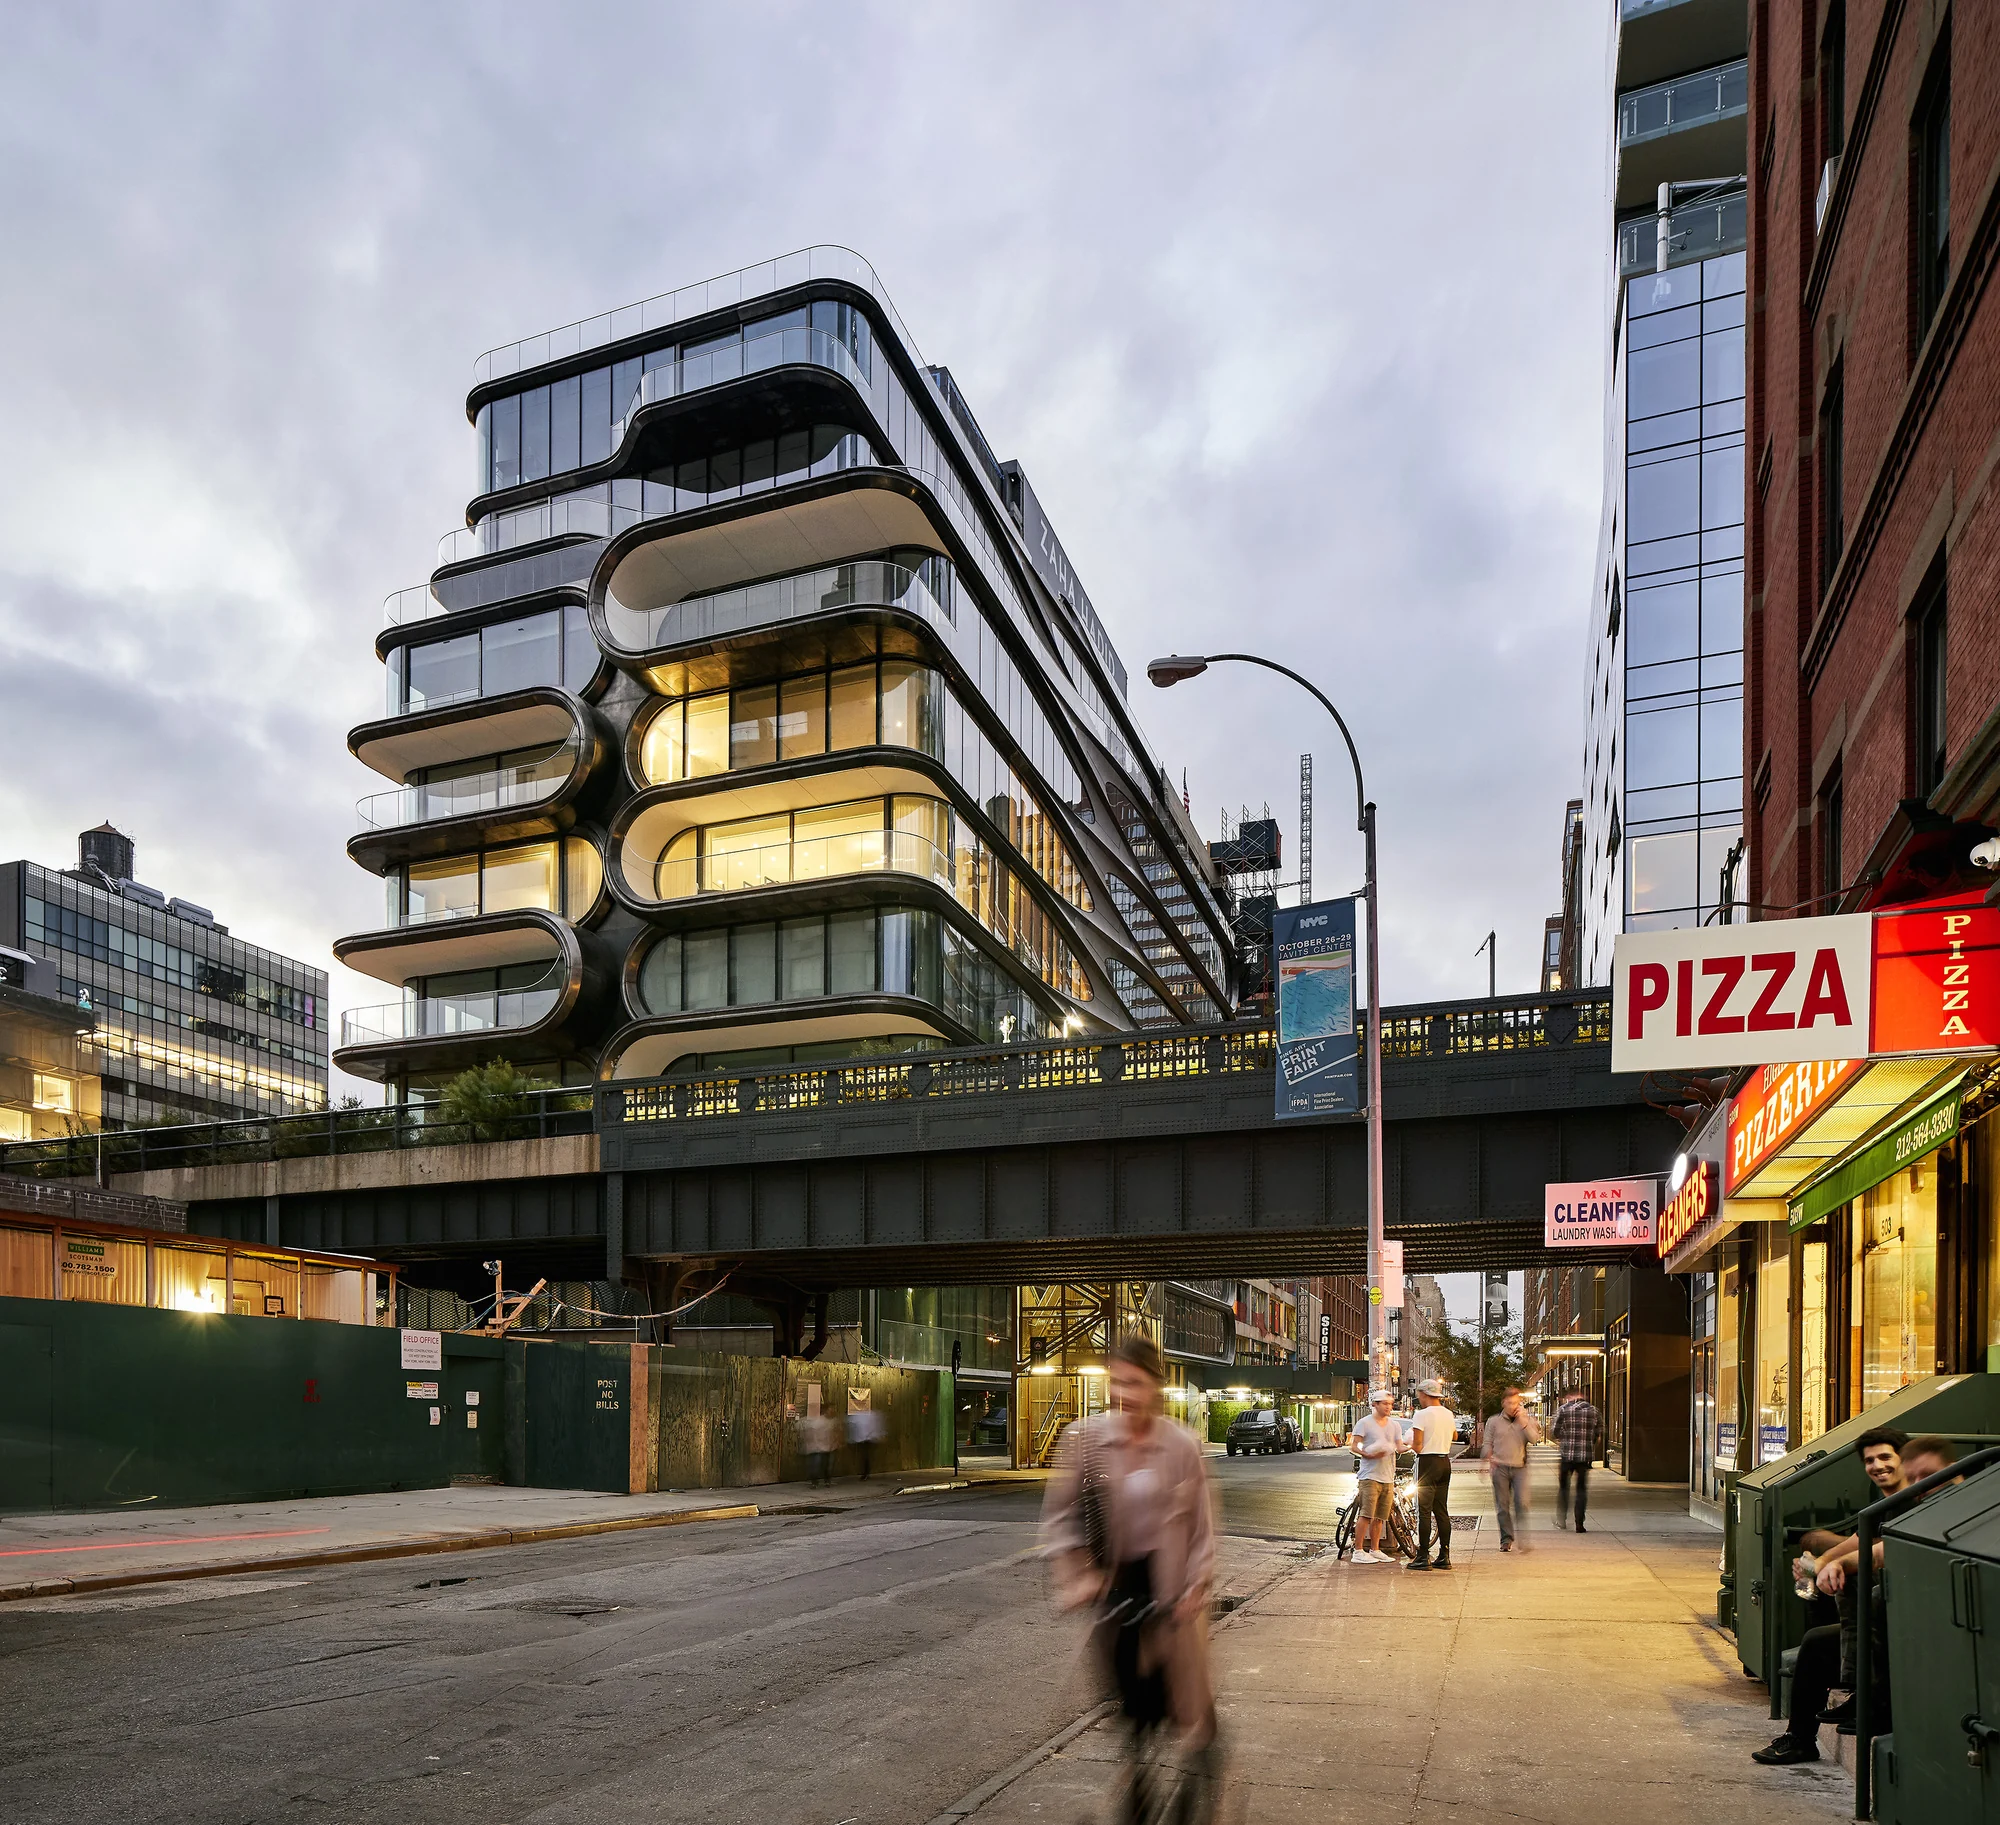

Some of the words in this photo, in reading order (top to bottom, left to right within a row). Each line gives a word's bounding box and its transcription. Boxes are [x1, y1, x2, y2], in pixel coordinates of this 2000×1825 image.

[1040, 519, 1076, 606] ZAHA
[1081, 597, 1115, 678] HADID
[1300, 915, 1328, 929] NYC
[1278, 938, 1322, 952] OCTOBER
[1278, 947, 1309, 960] JAVITS
[1313, 942, 1352, 954] CENTER
[1939, 915, 1972, 1036] PIZZA
[1628, 948, 1853, 1040] PIZZA
[1280, 1049, 1293, 1060] FINE
[1294, 1043, 1307, 1054] ART
[1281, 1040, 1326, 1069] PRINT
[1283, 1057, 1319, 1079] FAIR
[1291, 1098, 1308, 1107] IFPDA
[1895, 1102, 1955, 1162] 212-564-3330
[1583, 1189, 1596, 1199] M
[1611, 1189, 1622, 1198] N
[1554, 1200, 1651, 1223] CLEANERS
[1658, 1161, 1708, 1258] CLEANERS
[1552, 1227, 1591, 1240] LAUNDRY
[1592, 1226, 1617, 1239] WASH
[1881, 1216, 1892, 1237] 503
[69, 1244, 103, 1254] WILLIAMS
[69, 1254, 103, 1262] SCOTSMAN
[61, 1261, 115, 1273] 00.782.1500
[403, 1335, 419, 1344] FIELD
[419, 1336, 439, 1345] OFFICE
[1321, 1315, 1330, 1362] SCORE
[597, 1380, 618, 1388] POST
[601, 1390, 614, 1398] NO
[595, 1400, 619, 1409] BILLS
